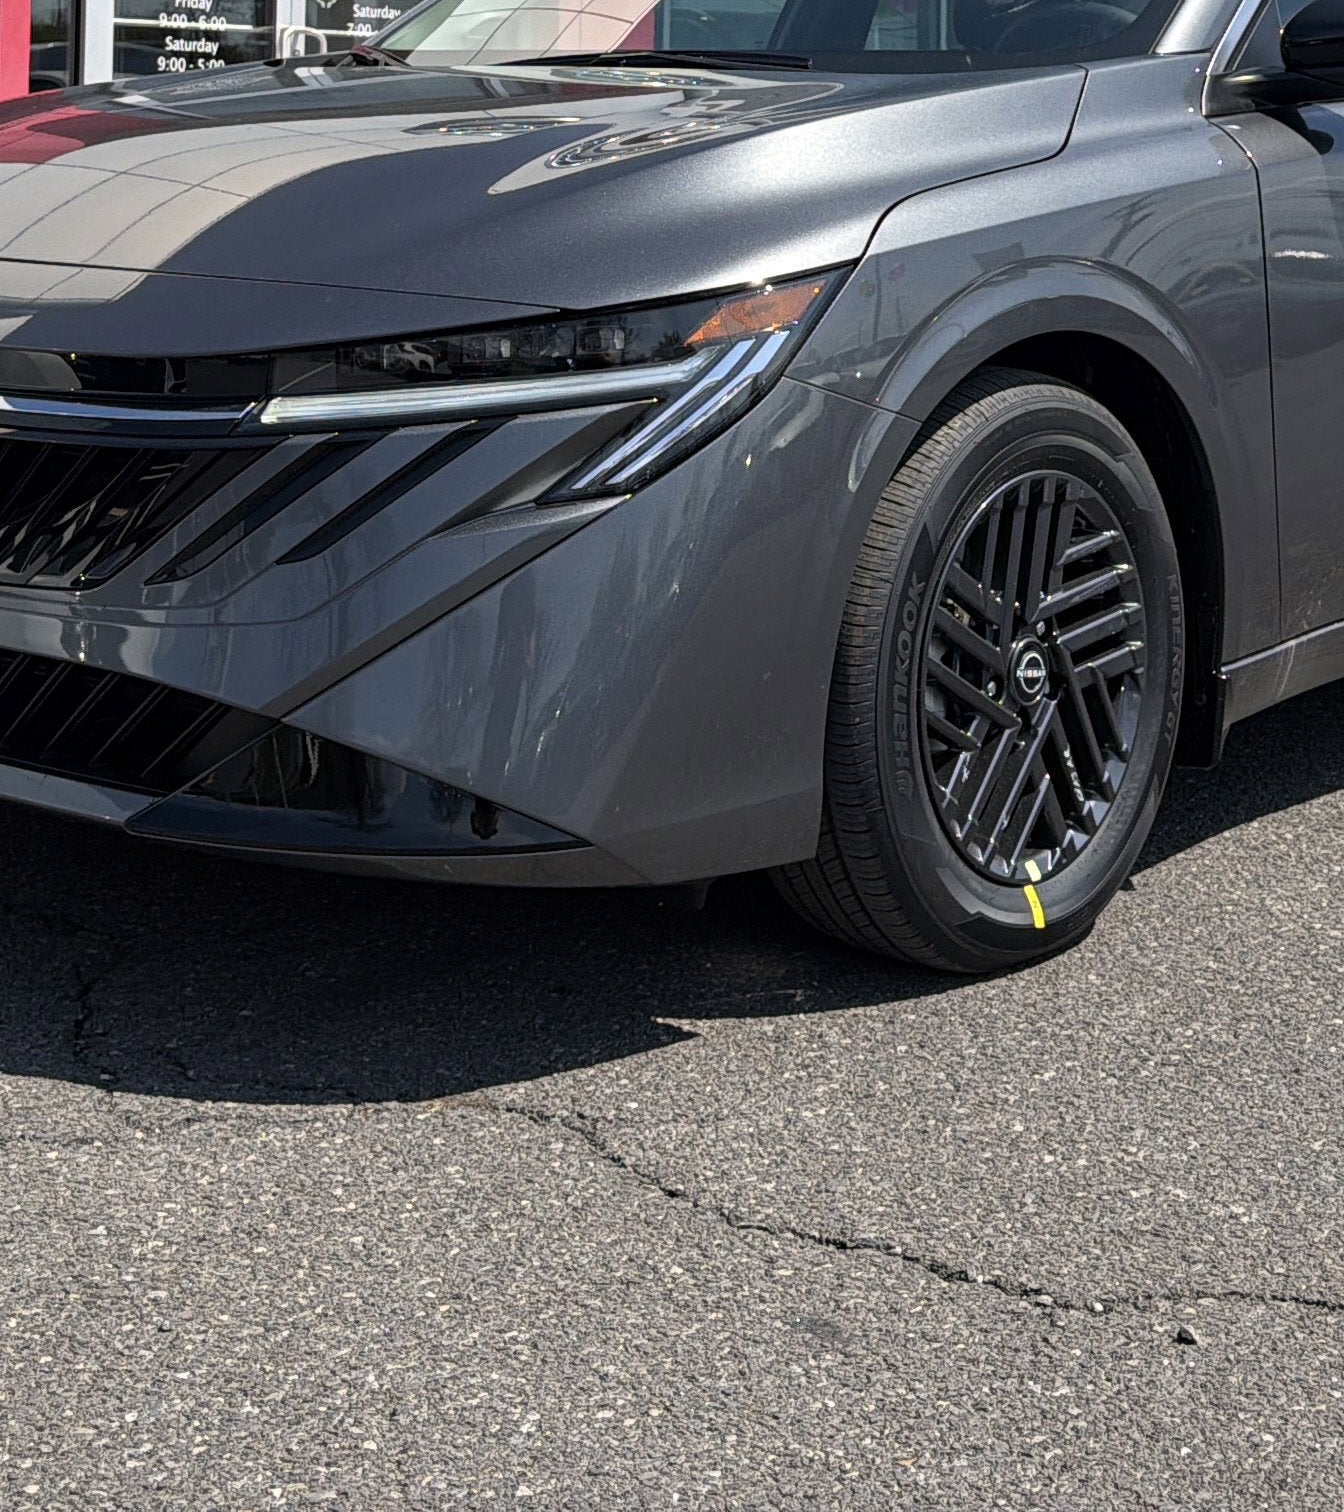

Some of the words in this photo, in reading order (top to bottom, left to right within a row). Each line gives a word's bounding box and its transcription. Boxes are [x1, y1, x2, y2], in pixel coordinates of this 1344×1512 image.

[165, 36, 220, 57] Saturday
[157, 56, 187, 73] 9:00
[1016, 669, 1047, 678] NISSAN
